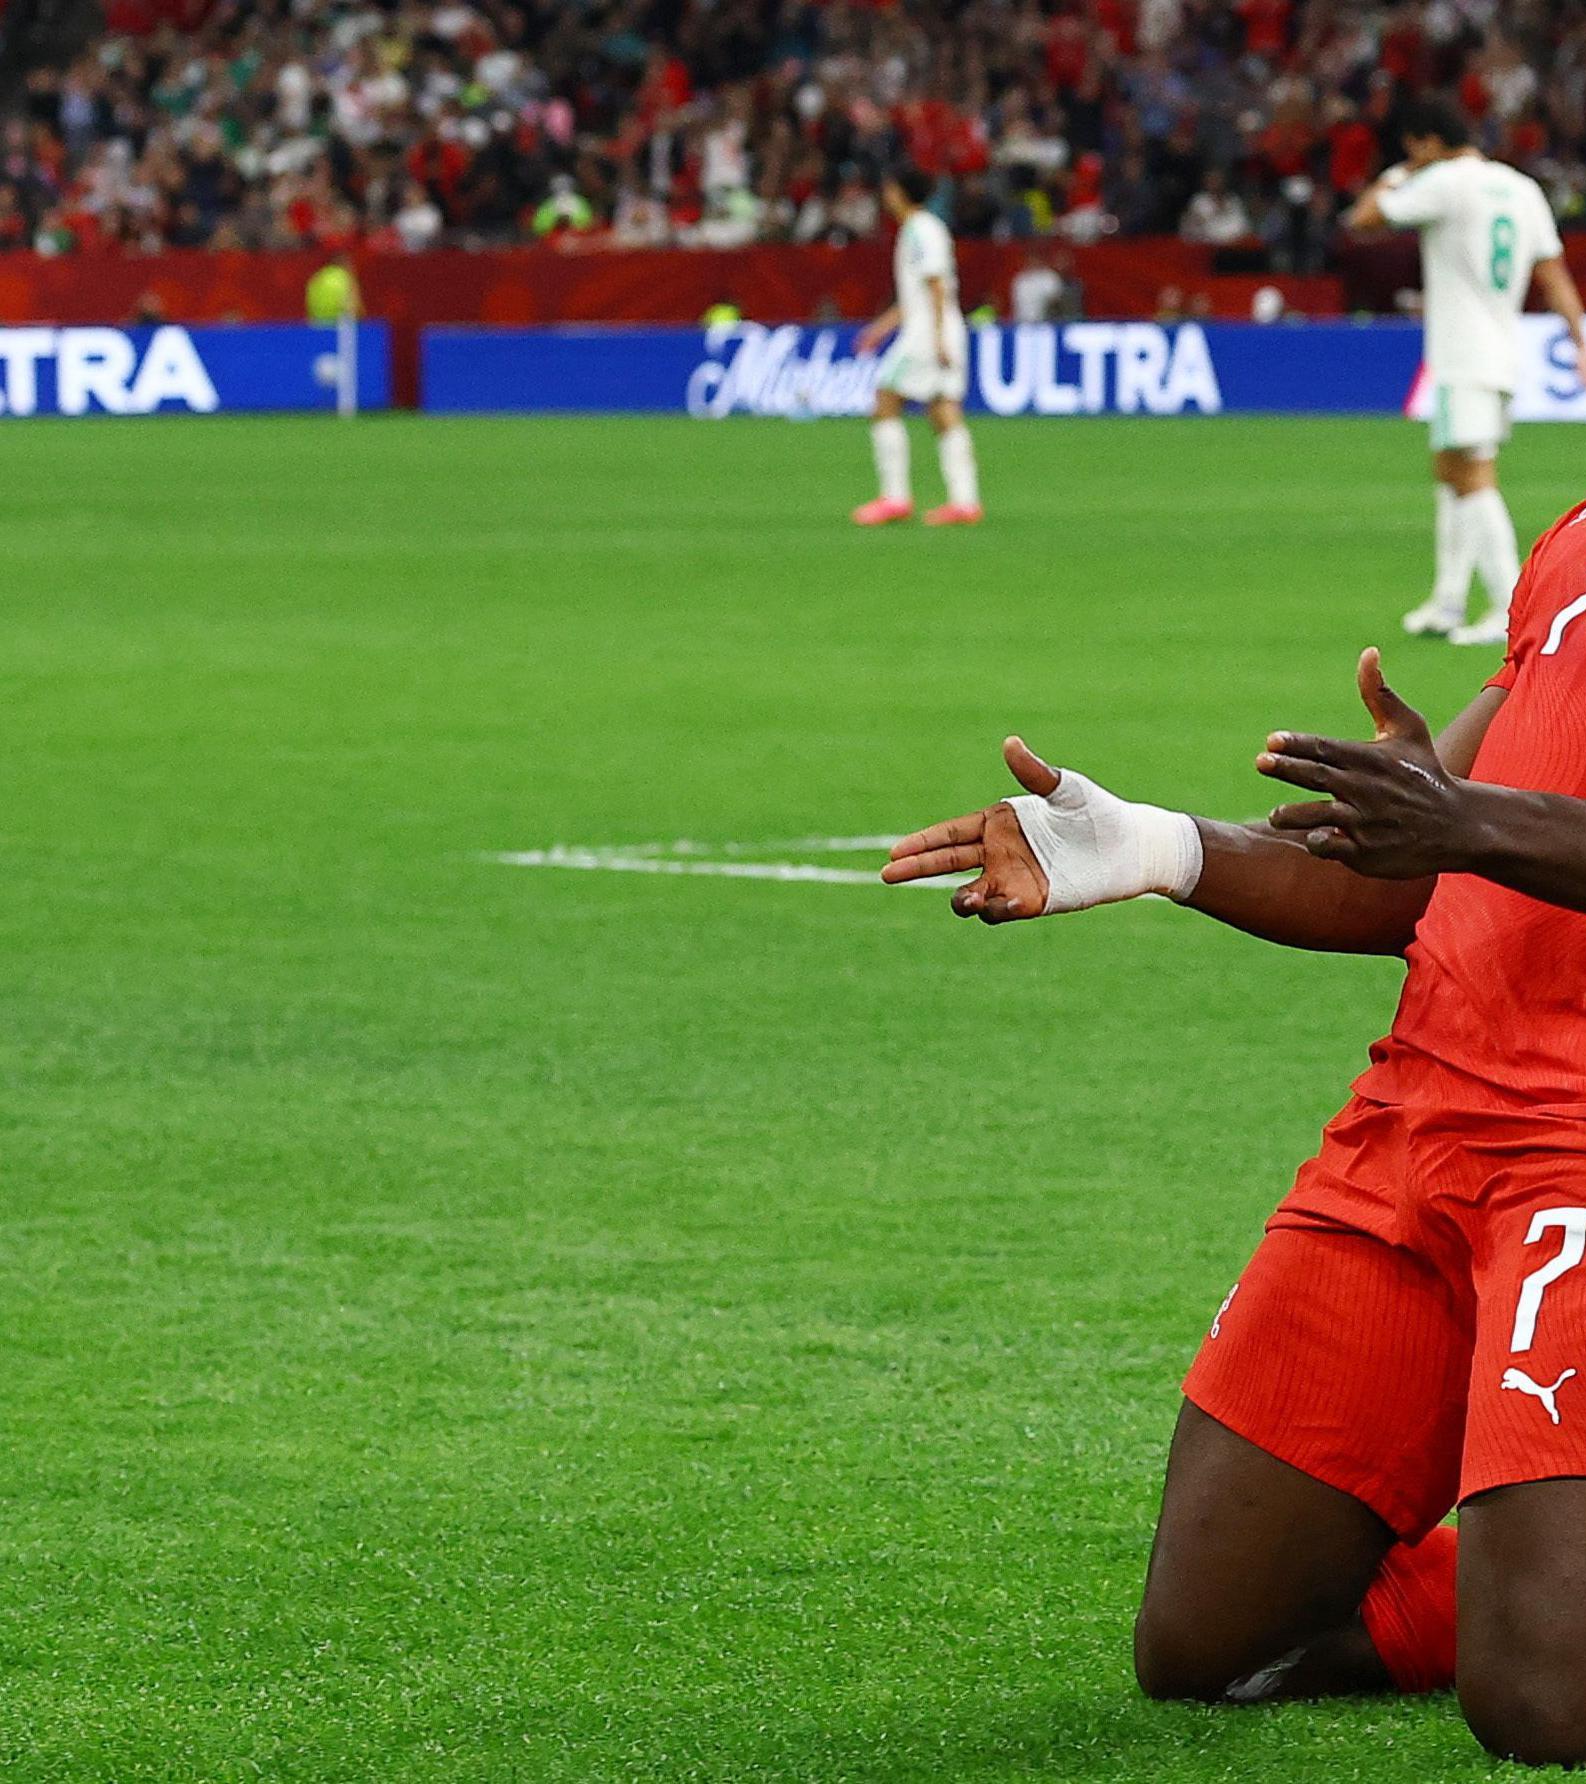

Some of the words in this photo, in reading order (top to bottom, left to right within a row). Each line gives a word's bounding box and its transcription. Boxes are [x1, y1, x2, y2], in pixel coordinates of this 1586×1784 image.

[1490, 214, 1517, 292] 8
[0, 325, 220, 416] TRA
[977, 322, 1221, 415] ULTRA
